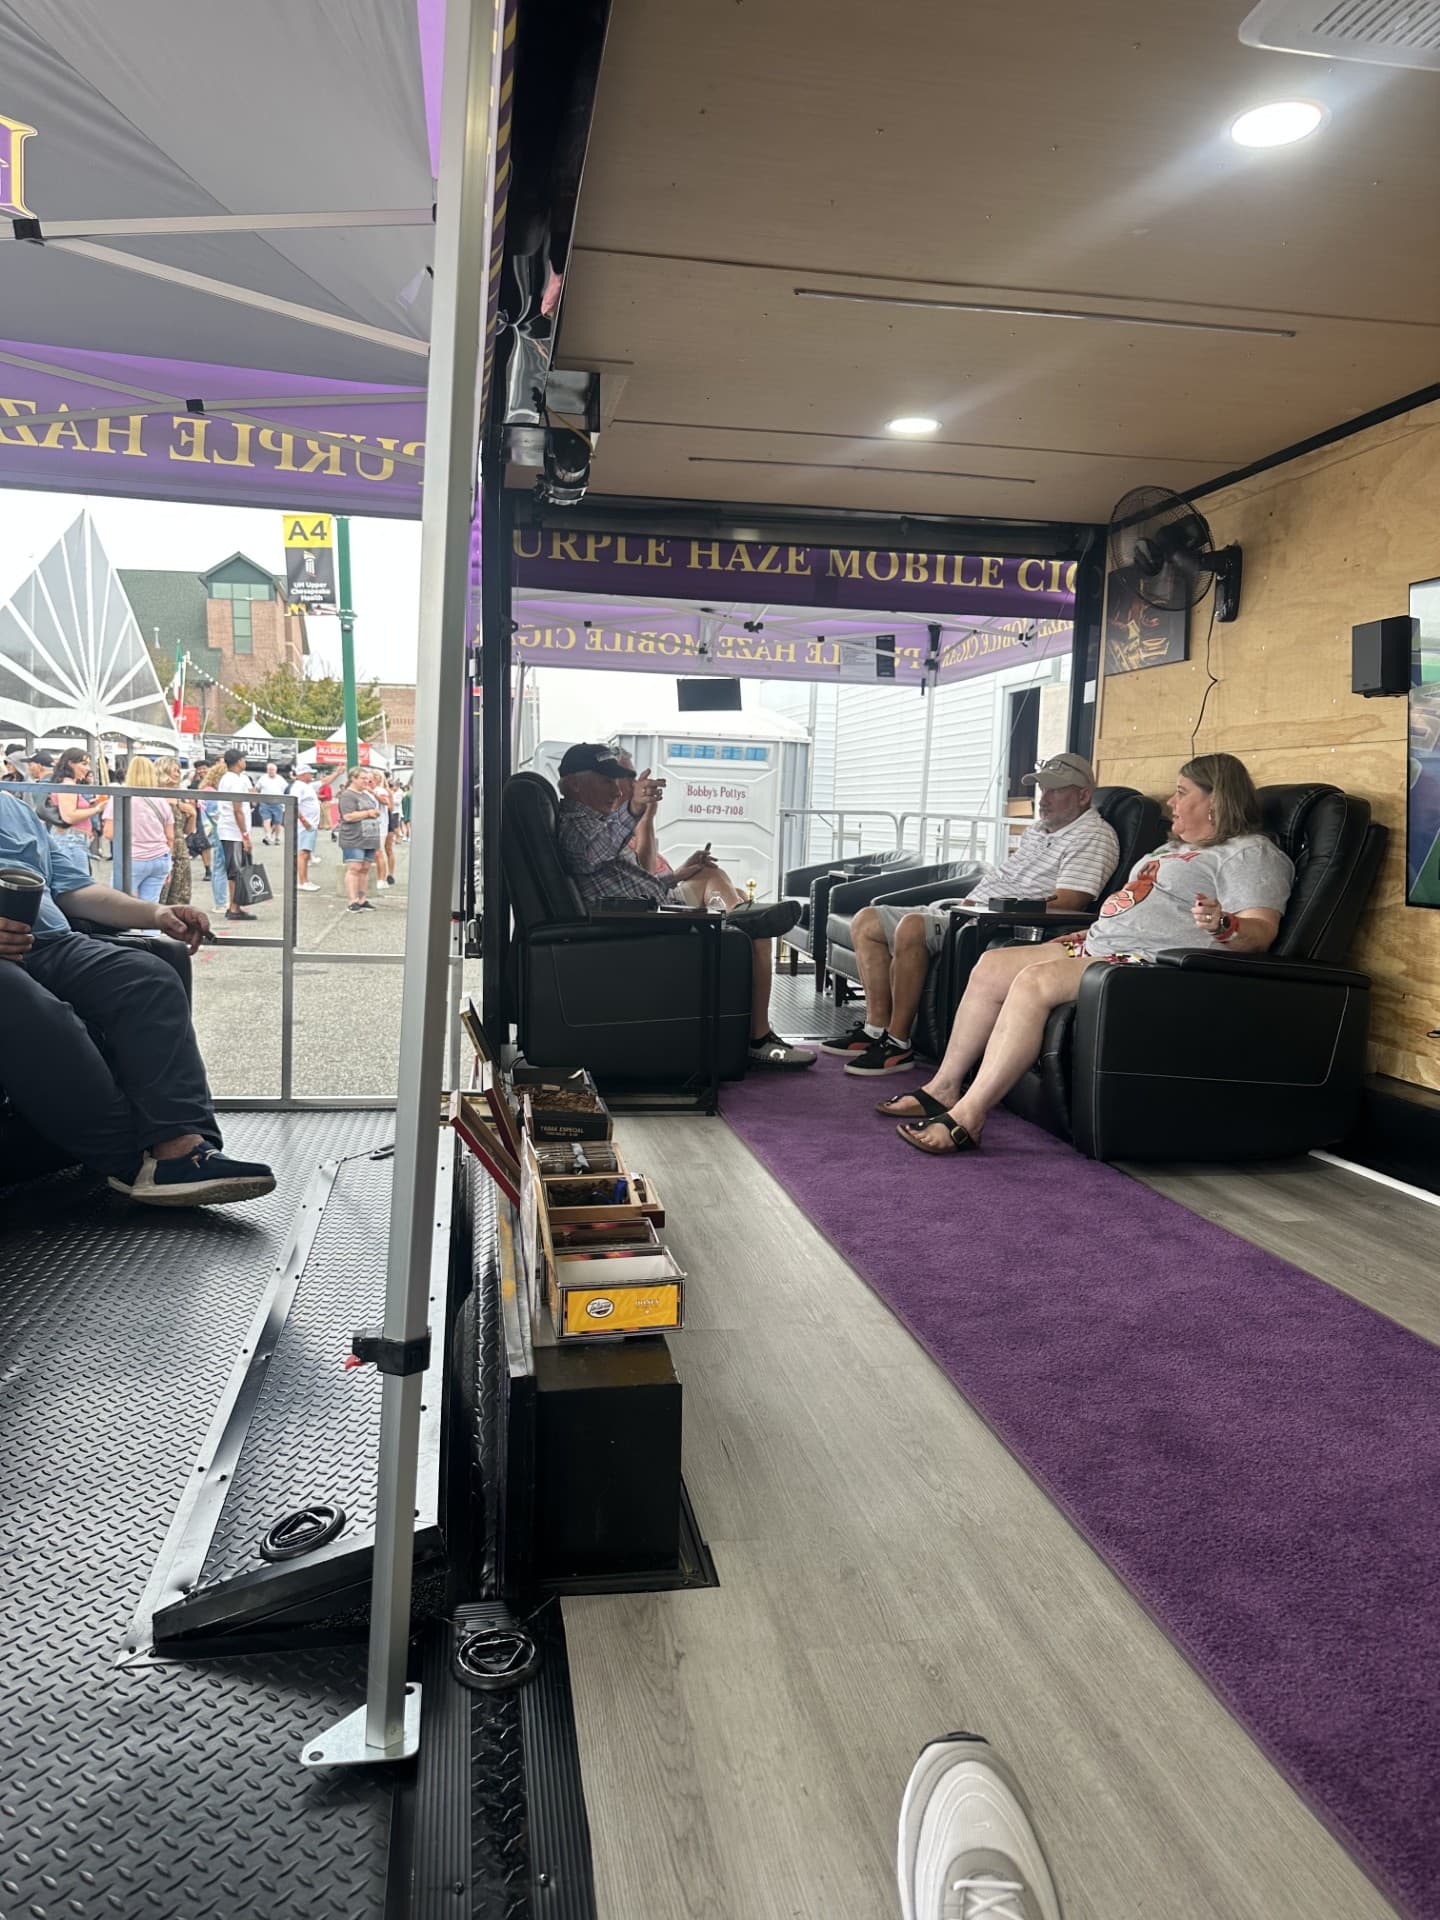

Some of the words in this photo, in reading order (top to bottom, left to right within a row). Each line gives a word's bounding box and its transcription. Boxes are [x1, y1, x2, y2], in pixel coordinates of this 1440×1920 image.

[288, 520, 328, 541] A4
[686, 540, 813, 576] HAZE
[826, 548, 1004, 589] MOBILE
[687, 785, 717, 799] Bobby's
